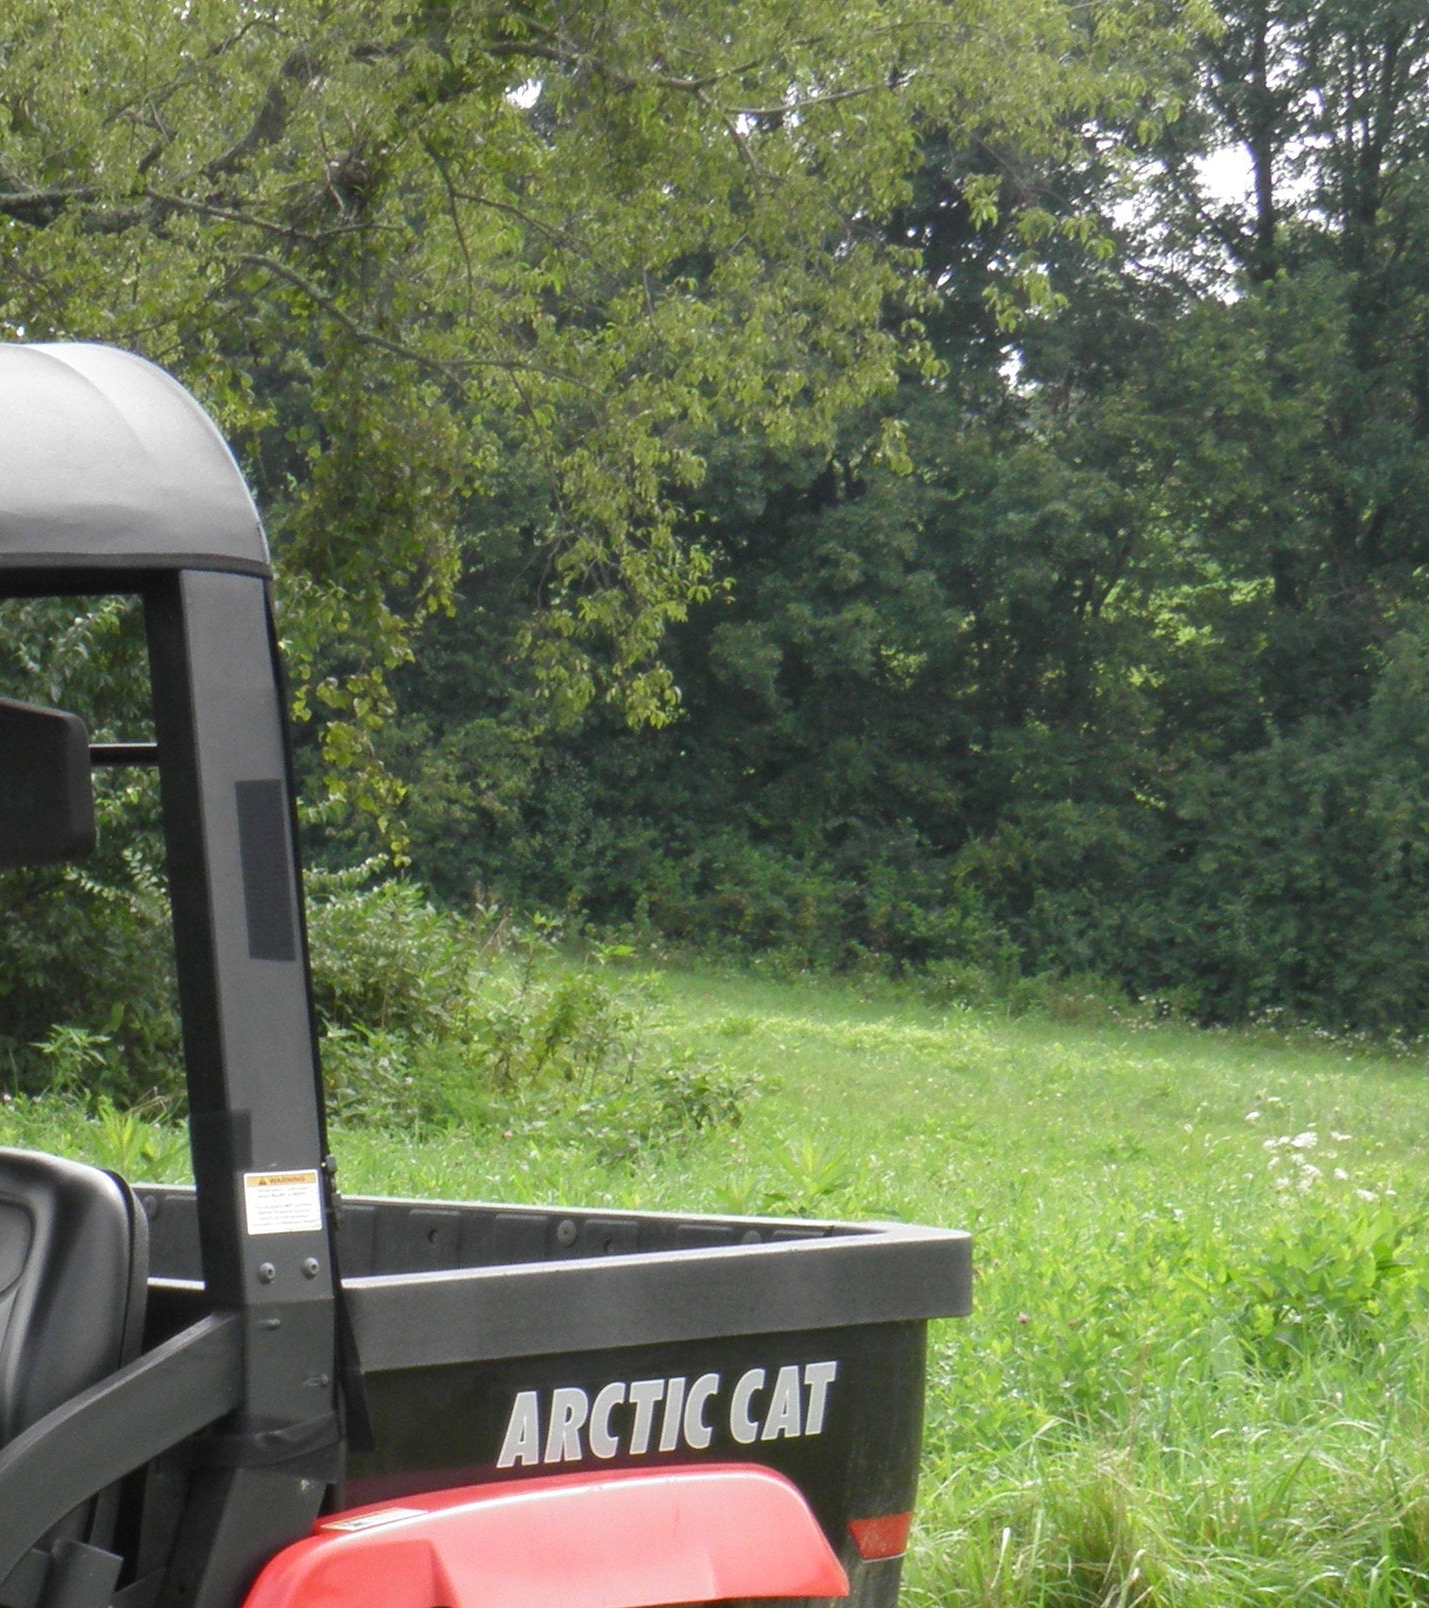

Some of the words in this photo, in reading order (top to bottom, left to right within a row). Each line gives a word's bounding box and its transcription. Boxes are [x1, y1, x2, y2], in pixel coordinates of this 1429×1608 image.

[269, 1175, 306, 1185] WARNING
[496, 1373, 720, 1469] ARCTIC
[729, 1361, 838, 1444] CAT
